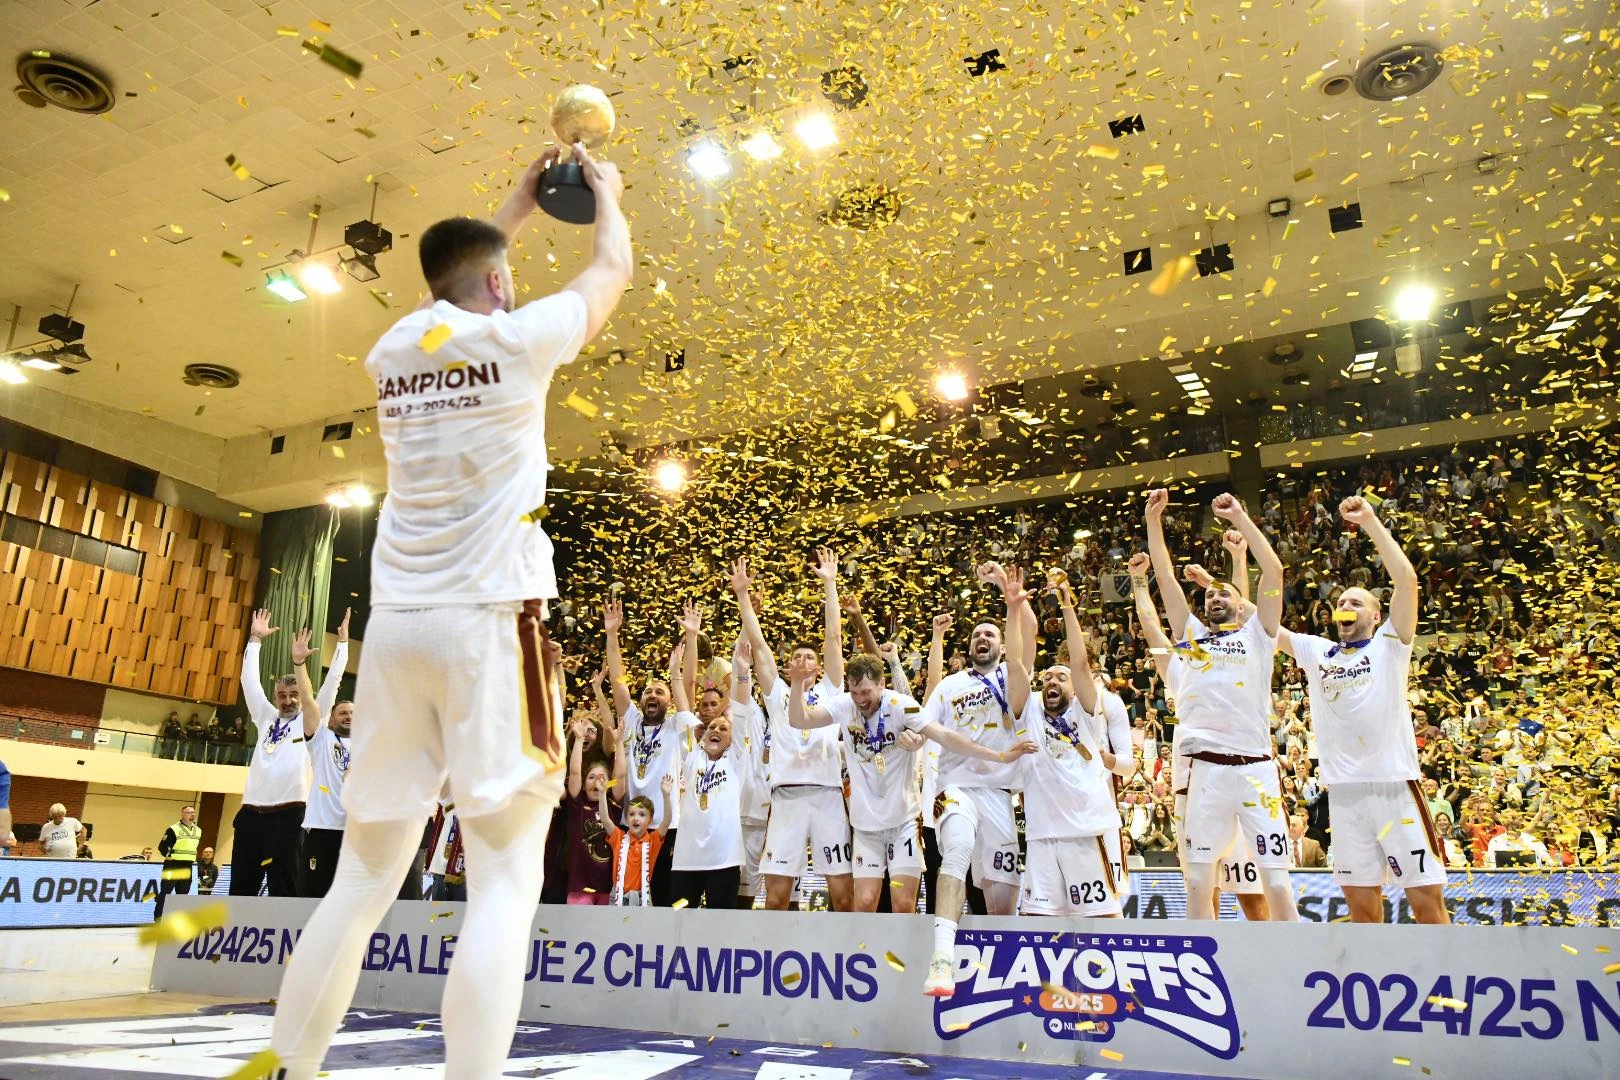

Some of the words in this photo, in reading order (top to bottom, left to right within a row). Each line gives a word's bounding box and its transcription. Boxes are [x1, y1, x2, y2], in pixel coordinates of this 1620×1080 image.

[904, 838, 913, 857] 1
[1270, 833, 1288, 856] 31
[1230, 863, 1257, 883] 16
[1411, 849, 1426, 873] 7
[32, 877, 160, 904] OPREMA
[1081, 880, 1106, 904] 23
[965, 933, 1003, 942] NLB
[1018, 935, 1059, 944] ABA
[1077, 937, 1166, 947] LEAGUE
[1183, 940, 1193, 948] 2
[361, 932, 413, 973] BA
[571, 941, 596, 985] 2
[603, 942, 878, 1003] CHAMPIONS
[940, 944, 1228, 1017] PLAYOFFS
[1052, 993, 1104, 1012] 2025
[1303, 971, 1564, 1040] 2024/25
